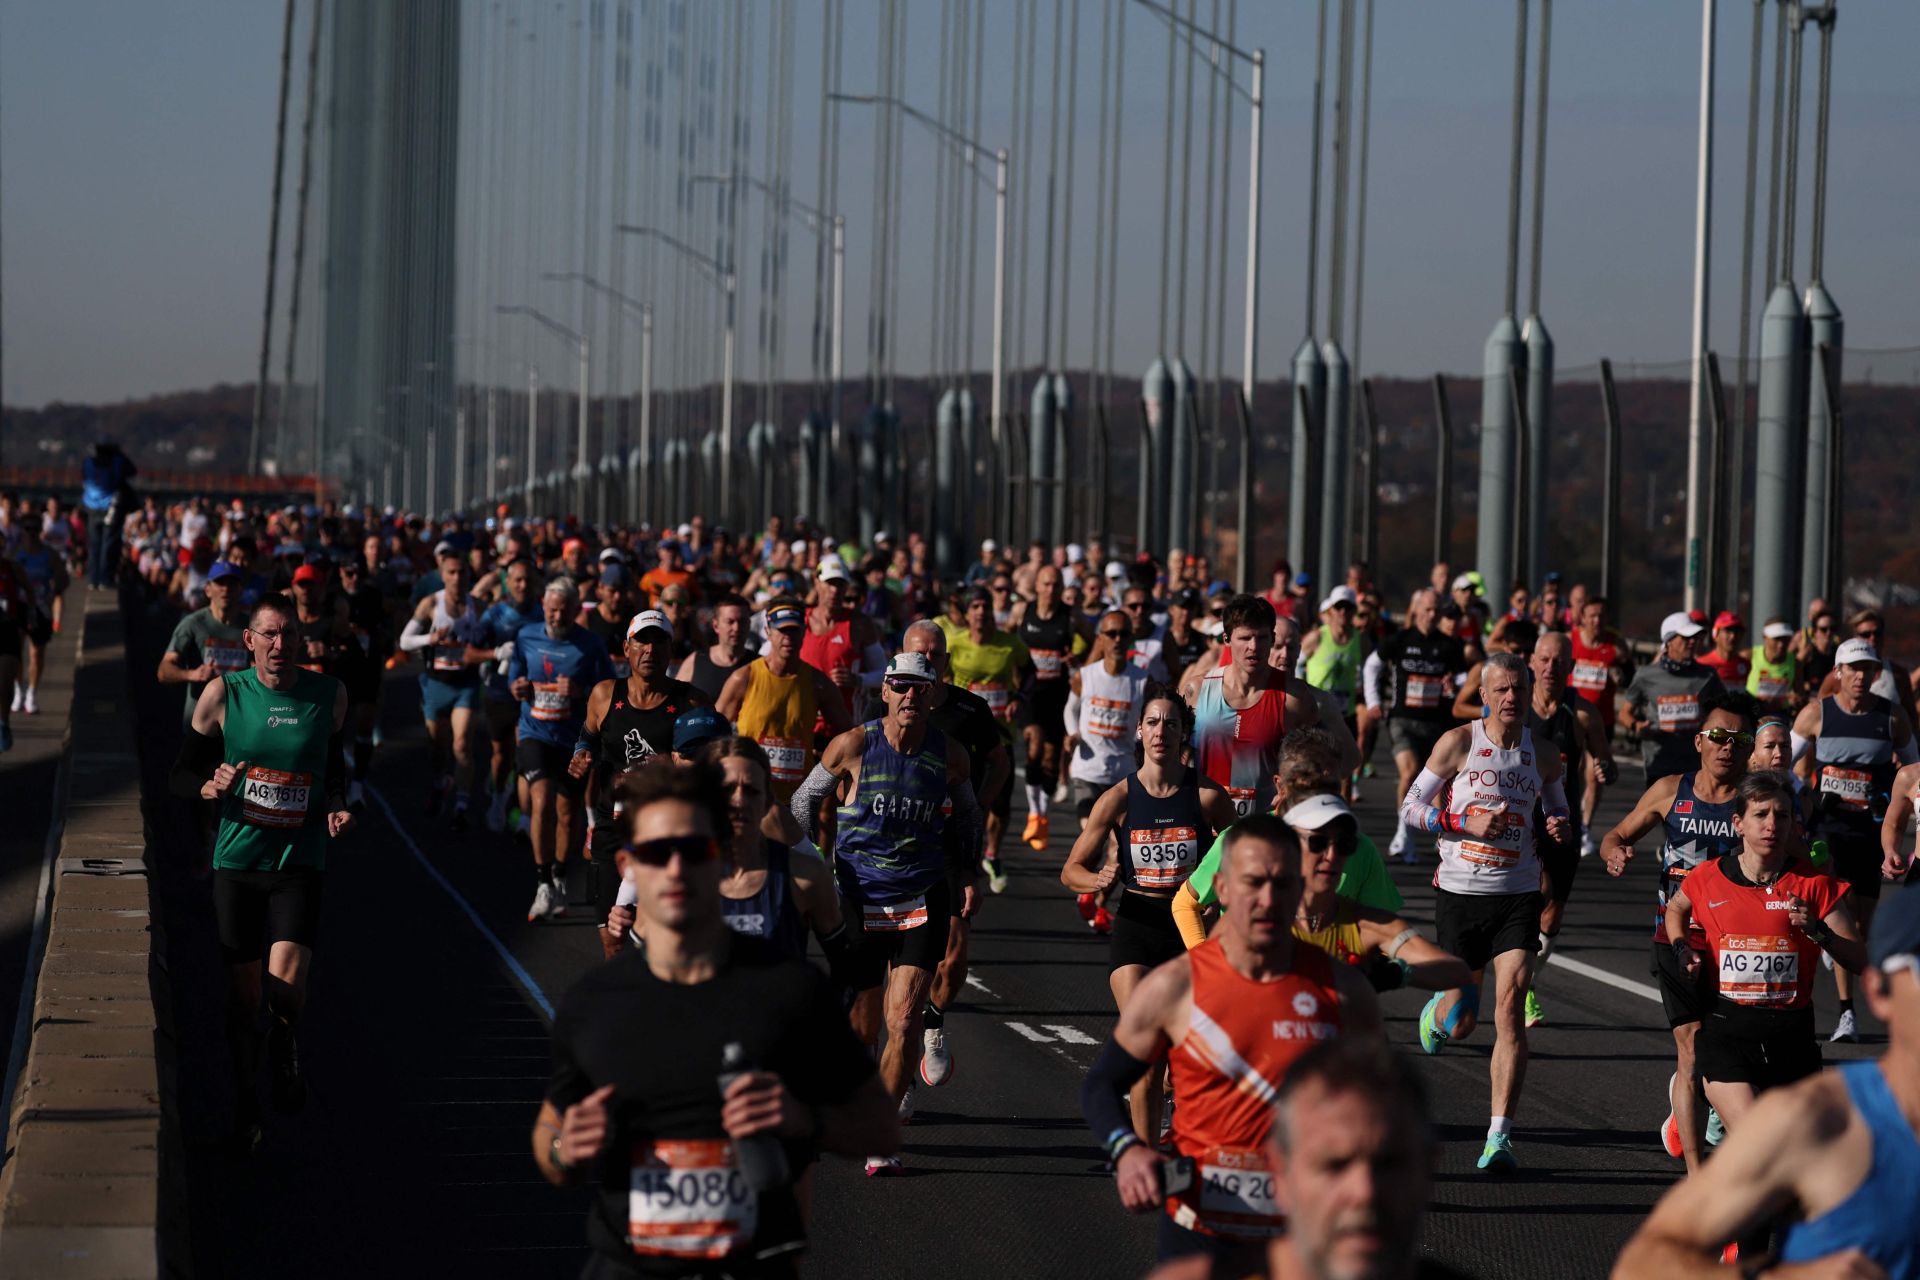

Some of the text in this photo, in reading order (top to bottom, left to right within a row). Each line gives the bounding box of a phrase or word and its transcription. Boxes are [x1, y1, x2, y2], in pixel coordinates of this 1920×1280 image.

[247, 782, 307, 803] AG 1613
[1469, 769, 1536, 797] POLSKA
[1823, 777, 1840, 790] AG
[872, 792, 935, 824] GARTH
[1140, 842, 1188, 863] 9356
[1765, 901, 1791, 911] GERMA
[1728, 937, 1746, 949] tcs
[1722, 953, 1795, 973] AG 2167
[641, 1171, 748, 1207] 15080
[1206, 1173, 1276, 1200] AG 20
